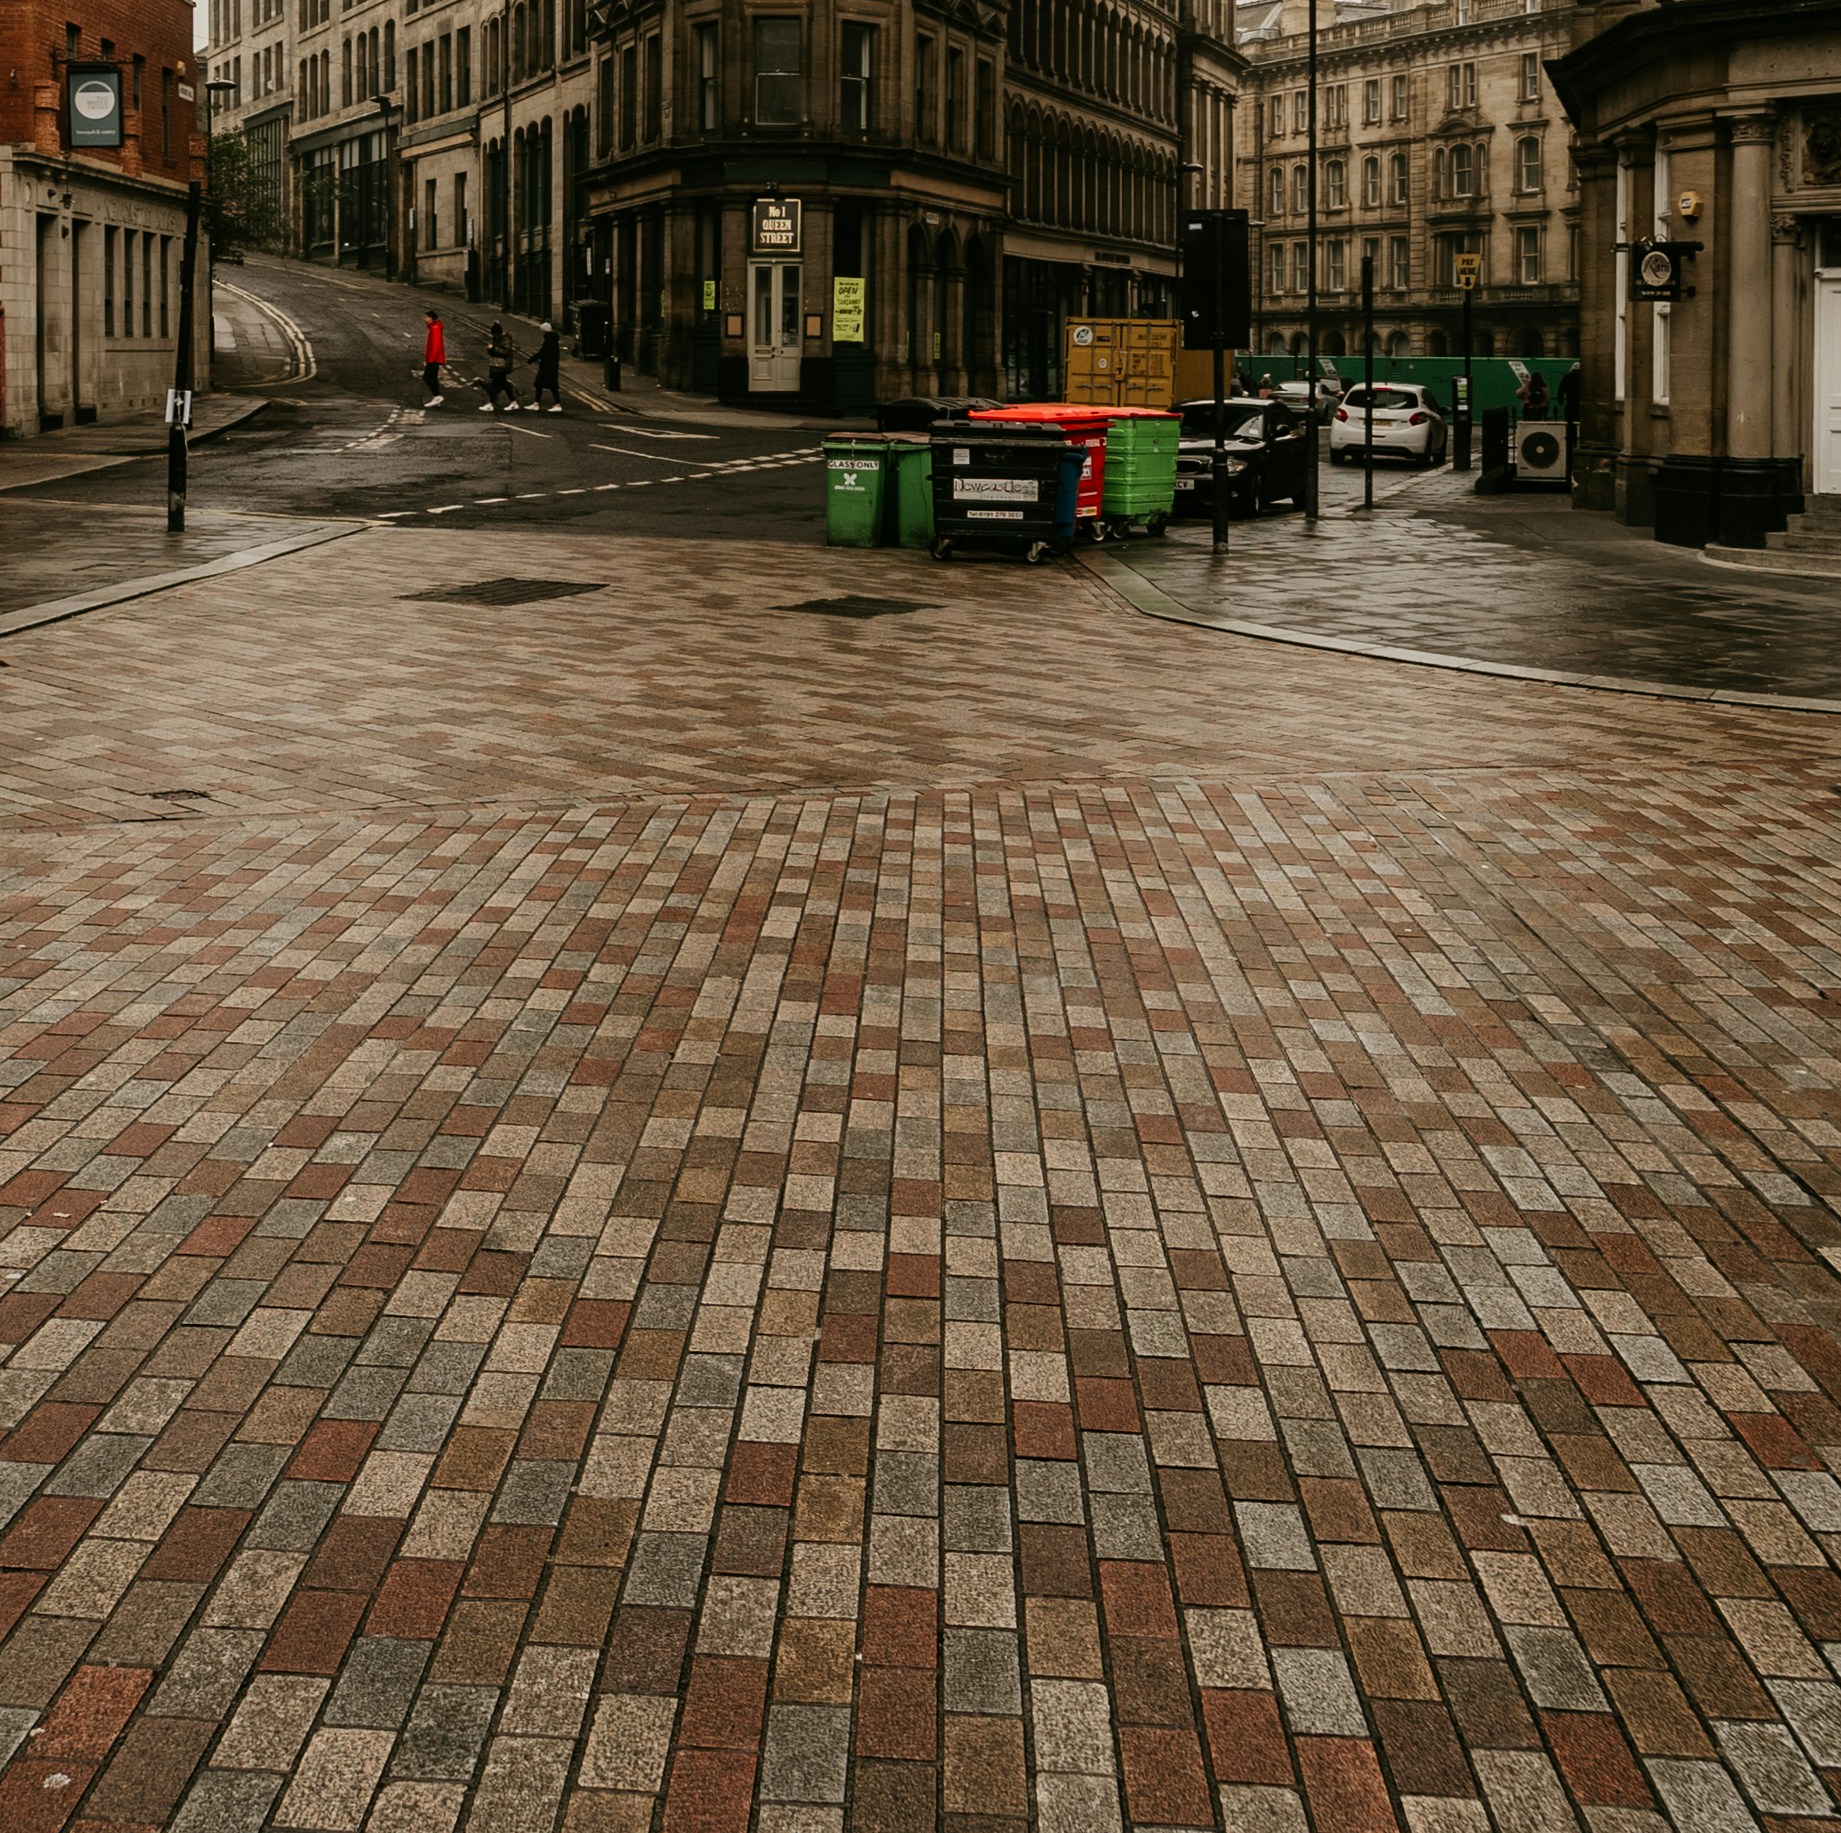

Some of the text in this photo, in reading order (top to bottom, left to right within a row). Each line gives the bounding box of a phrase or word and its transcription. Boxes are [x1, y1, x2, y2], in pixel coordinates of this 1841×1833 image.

[762, 219, 792, 231] QUEEN
[760, 232, 794, 244] STREET
[828, 460, 854, 468] GLASS
[954, 478, 1023, 493] Newcastle
